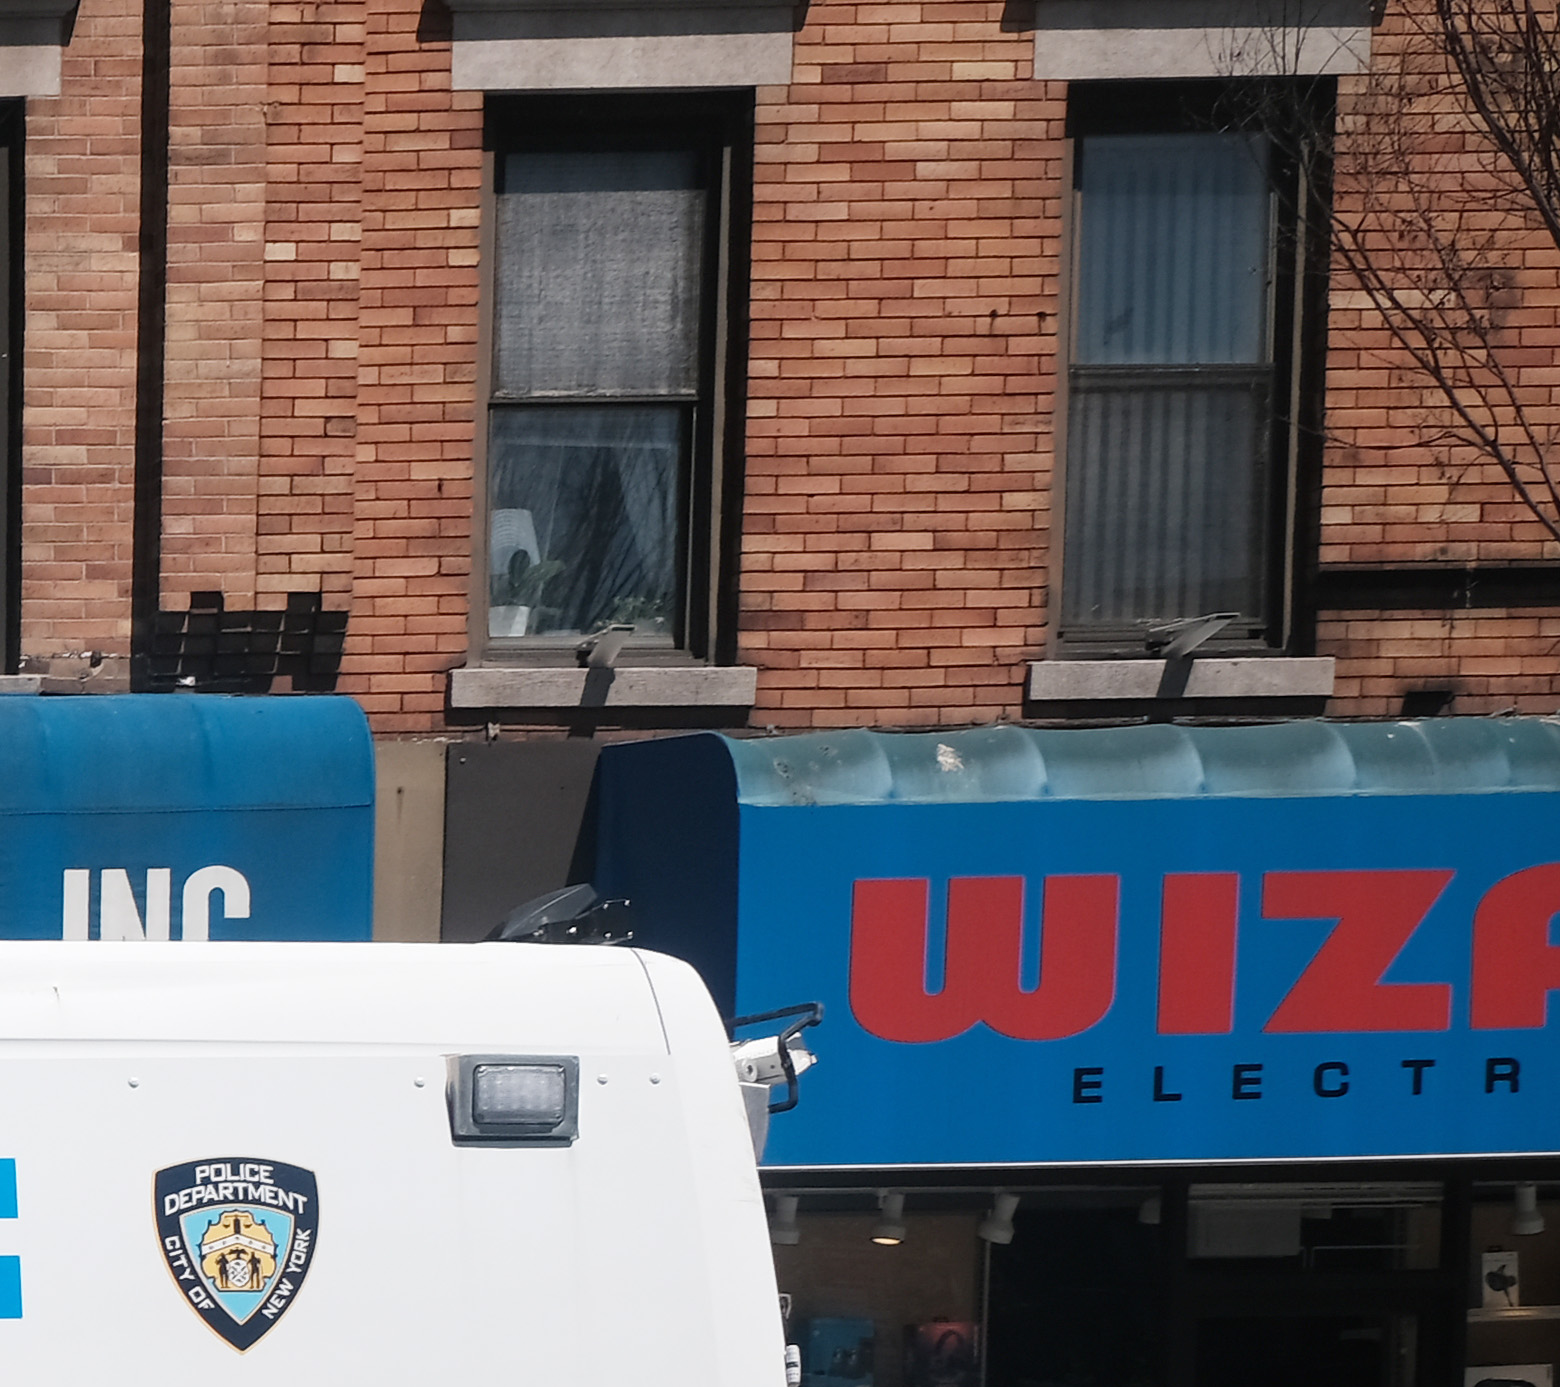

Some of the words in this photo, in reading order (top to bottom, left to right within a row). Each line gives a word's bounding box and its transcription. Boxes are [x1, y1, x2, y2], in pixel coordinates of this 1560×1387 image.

[1072, 1057, 1521, 1103] ELECTR
[195, 1163, 274, 1184] POLICE
[164, 1183, 308, 1216] DEPARTMENT
[165, 1236, 195, 1281] CITY
[188, 1286, 215, 1309] OF
[262, 1279, 294, 1319] NEW
[287, 1228, 311, 1273] YORK
